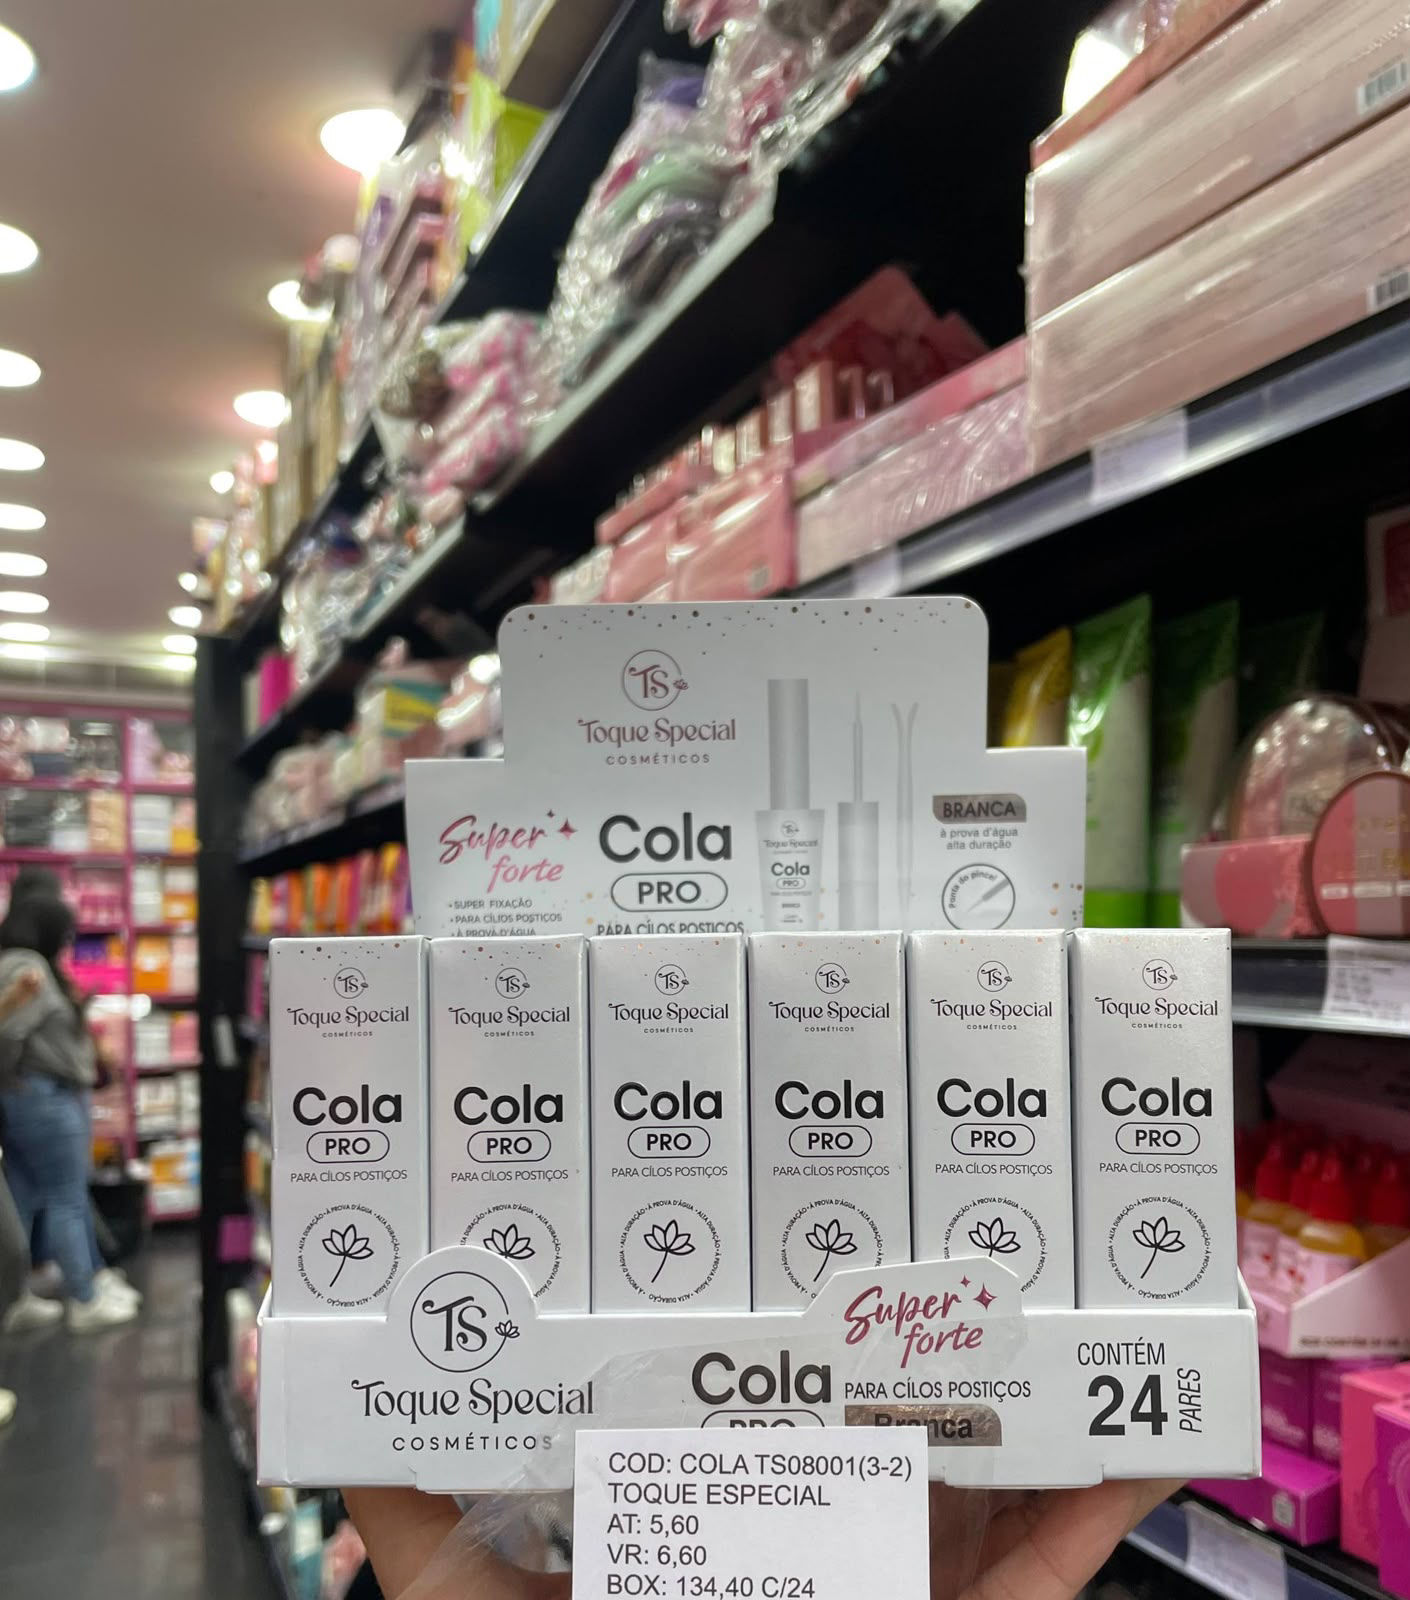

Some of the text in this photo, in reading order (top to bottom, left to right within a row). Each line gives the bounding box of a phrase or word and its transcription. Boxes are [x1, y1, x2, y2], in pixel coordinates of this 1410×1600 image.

[629, 665, 669, 698] TS
[578, 718, 735, 748] Toque Special
[605, 753, 709, 765] COSMÉTICOS
[944, 801, 1016, 818] BRANCA
[439, 815, 548, 864] Super
[599, 812, 731, 863] Cola
[947, 841, 1012, 850] alta duração
[487, 856, 565, 894] forte
[771, 862, 810, 876] Cola
[638, 881, 701, 904] PRO
[454, 898, 532, 909] SUPER FIXAÇÃO
[456, 915, 480, 923] PARA
[597, 924, 631, 935] PARA
[637, 920, 675, 934] CÍLOS
[338, 975, 359, 993] TS
[499, 975, 521, 993] TS
[658, 972, 679, 989] TS
[819, 970, 841, 988] TS
[981, 968, 1002, 986] TS
[1146, 966, 1168, 983] TS
[287, 1006, 408, 1028] Toque Special
[448, 1006, 569, 1028] Toque Special
[608, 1003, 728, 1024] Toque Special
[769, 1001, 889, 1022] Toque Special
[931, 999, 1052, 1020] Toque Special
[1095, 997, 1217, 1019] Toque Special
[293, 1084, 401, 1126] Cola
[454, 1084, 563, 1125] Cola
[614, 1080, 722, 1121] Cola
[775, 1080, 883, 1119] Cola
[937, 1078, 1046, 1118] Cola
[1102, 1077, 1212, 1117] Cola
[326, 1137, 370, 1155] PRO
[487, 1137, 532, 1155] PRO
[647, 1133, 691, 1150] PRO
[809, 1132, 853, 1149] PRO
[971, 1131, 1016, 1148] PRO
[1136, 1130, 1181, 1147] PRO
[291, 1170, 407, 1182] PARA CÍLOS POSTIÇOS
[451, 1170, 568, 1182] PARA CÍLOS POSTIÇOS
[612, 1166, 727, 1178] PARA CÍLOS POSTIÇOS
[773, 1164, 889, 1178] PARA CÍLOS POSTIÇOS
[936, 1163, 1052, 1176] PARA CÍLOS POSTIÇOS
[1100, 1162, 1217, 1176] PARA CÍLOS POSTIÇOS
[422, 1296, 487, 1352] TS
[844, 1286, 961, 1345] Super
[900, 1322, 983, 1368] forte
[1078, 1337, 1165, 1365] CONTÉM
[692, 1350, 831, 1405] Cola
[845, 1377, 1031, 1402] PARA CÍLOS POSTIÇOS
[351, 1378, 593, 1424] Toque Special
[1088, 1375, 1168, 1436] 24
[1177, 1368, 1202, 1433] PARES
[392, 1433, 551, 1450] COSMÉTICOS
[609, 1452, 911, 1481] COD: COLA TS08001(3-2)
[608, 1483, 830, 1506] TOQUE ESPECIAL
[607, 1514, 698, 1538] AT: 5,60
[607, 1544, 706, 1568] VR: 6,60
[608, 1574, 815, 1600] BOX: 134,40 C/24
